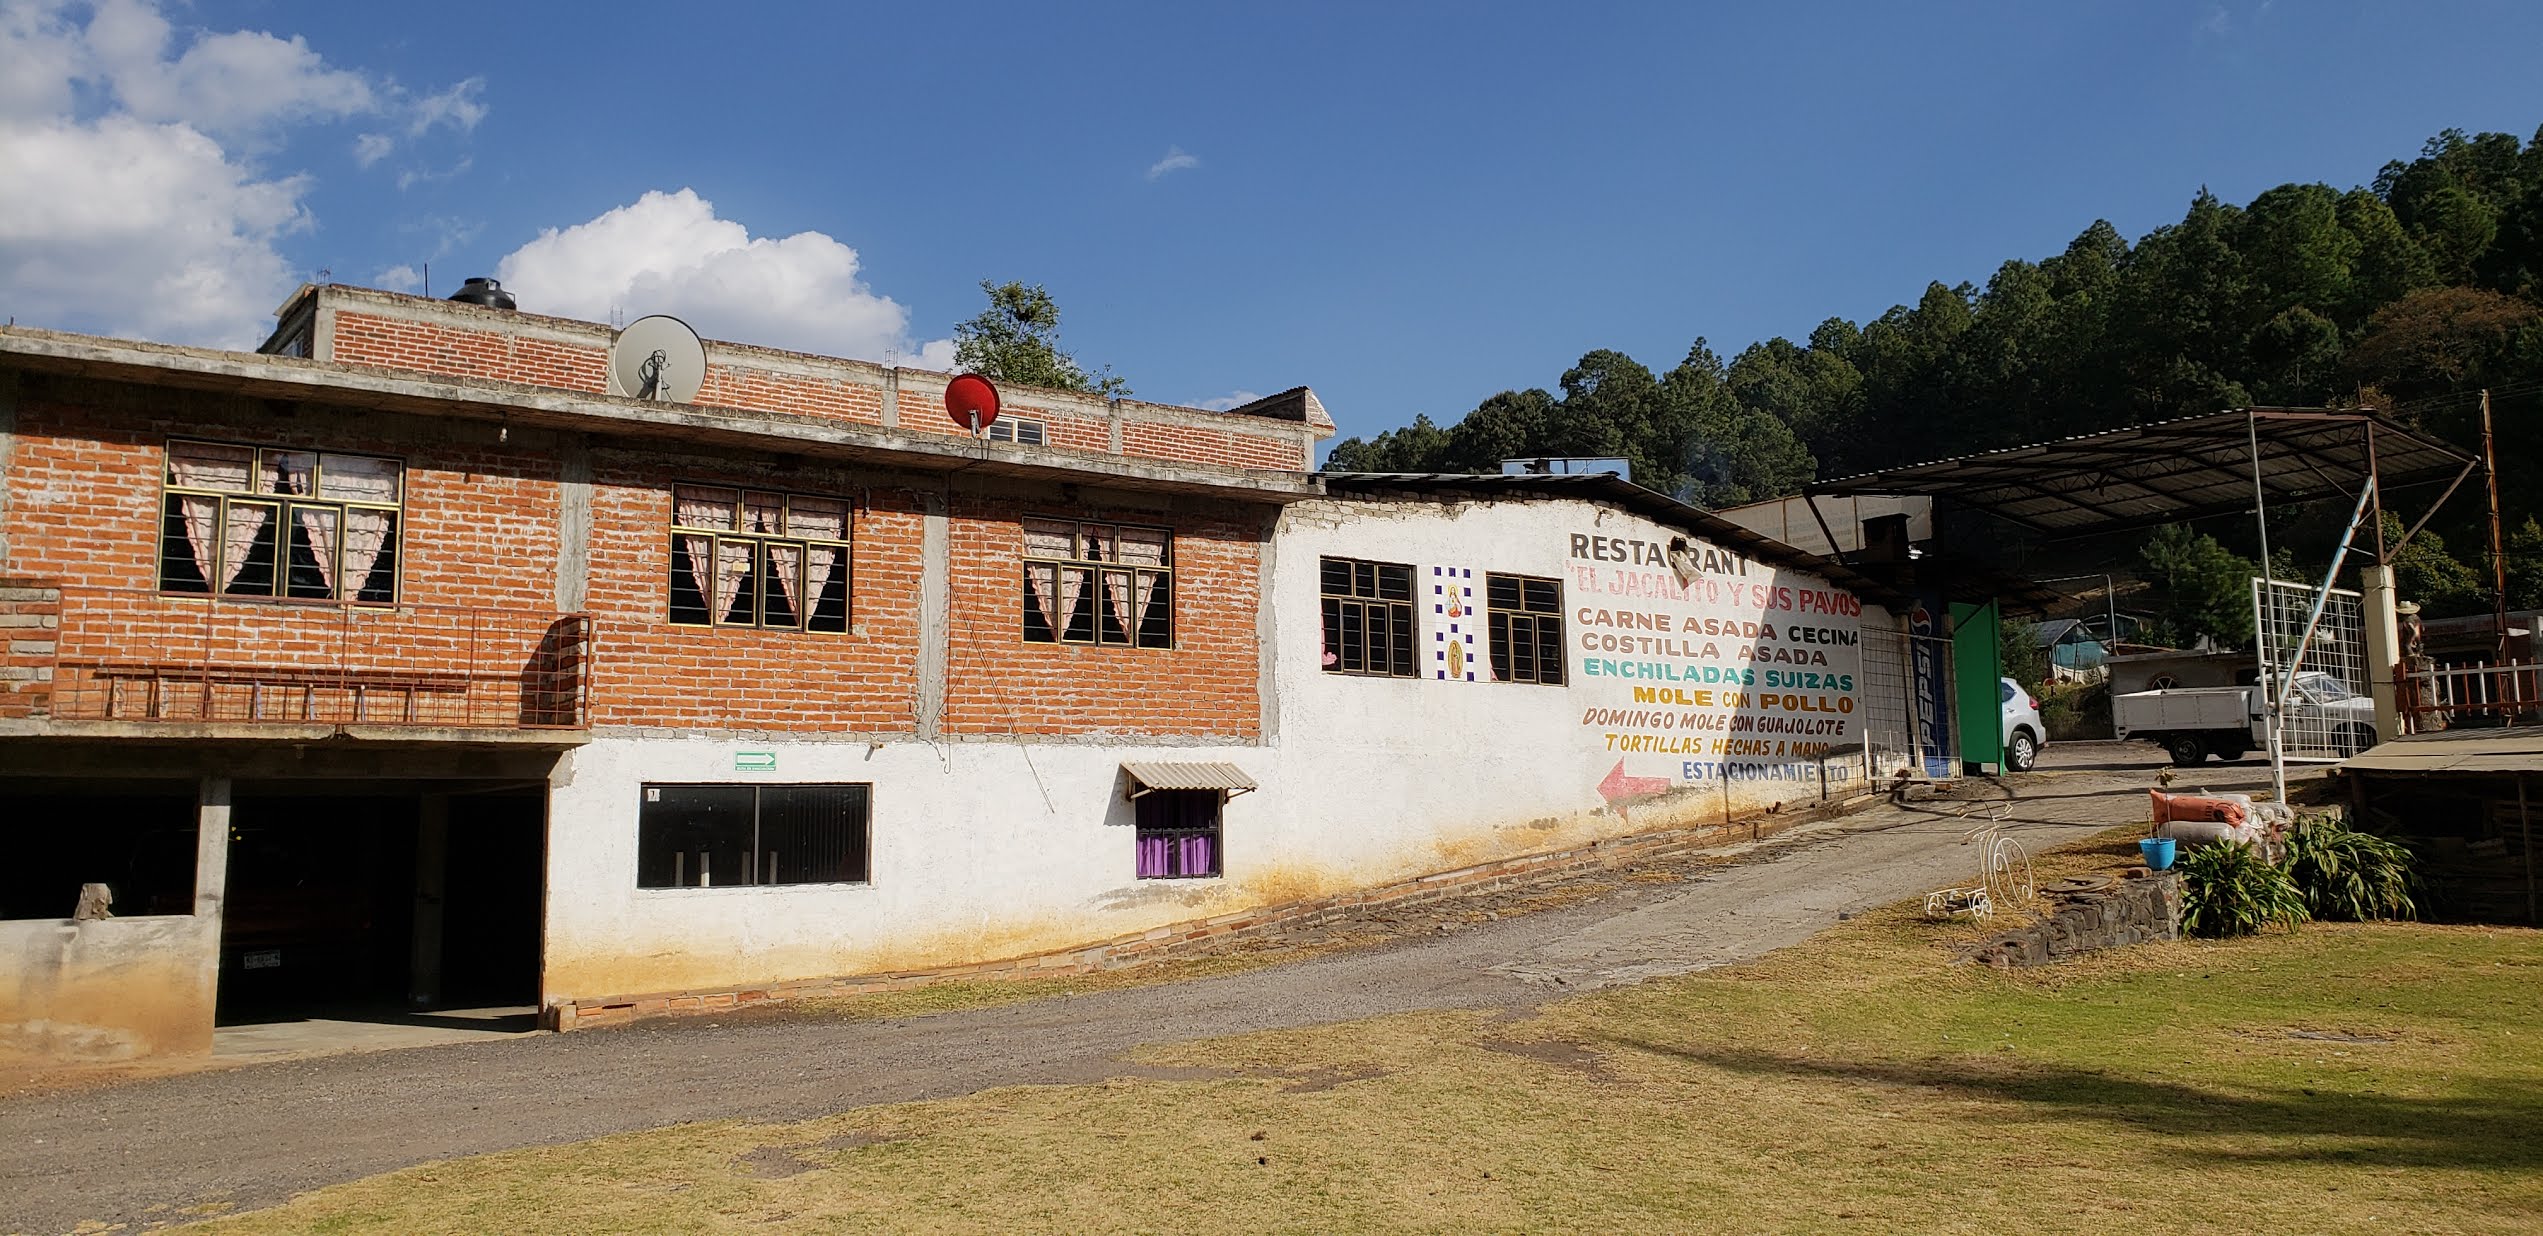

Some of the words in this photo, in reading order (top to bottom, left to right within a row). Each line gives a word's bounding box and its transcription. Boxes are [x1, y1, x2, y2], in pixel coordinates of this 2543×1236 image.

[1727, 581, 1744, 606] Y
[1752, 584, 1793, 611] SUS
[1799, 589, 1860, 617] PAVOS
[1577, 608, 1671, 632] CARNE
[1683, 617, 1777, 640] ASADA
[1788, 626, 1858, 646] CECINA
[1582, 632, 1720, 659] COSTILLA
[1738, 645, 1828, 666] ASADA
[1584, 658, 1755, 686] ENCHILADAS
[1765, 670, 1853, 691] SUIZAS
[1633, 686, 1713, 706] MOLE
[1723, 691, 1751, 709] CON
[1760, 694, 1853, 713] POLLO
[1916, 641, 1936, 753] PEPSI
[1582, 707, 1674, 729] DOMINGO
[1680, 713, 1726, 731] MOLE
[1729, 715, 1753, 732] CON
[1757, 717, 1845, 736] GUAJOLOTE
[1605, 734, 1702, 754] TORTILLAS
[1711, 739, 1771, 756] HECHAS
[1775, 741, 1785, 757] A
